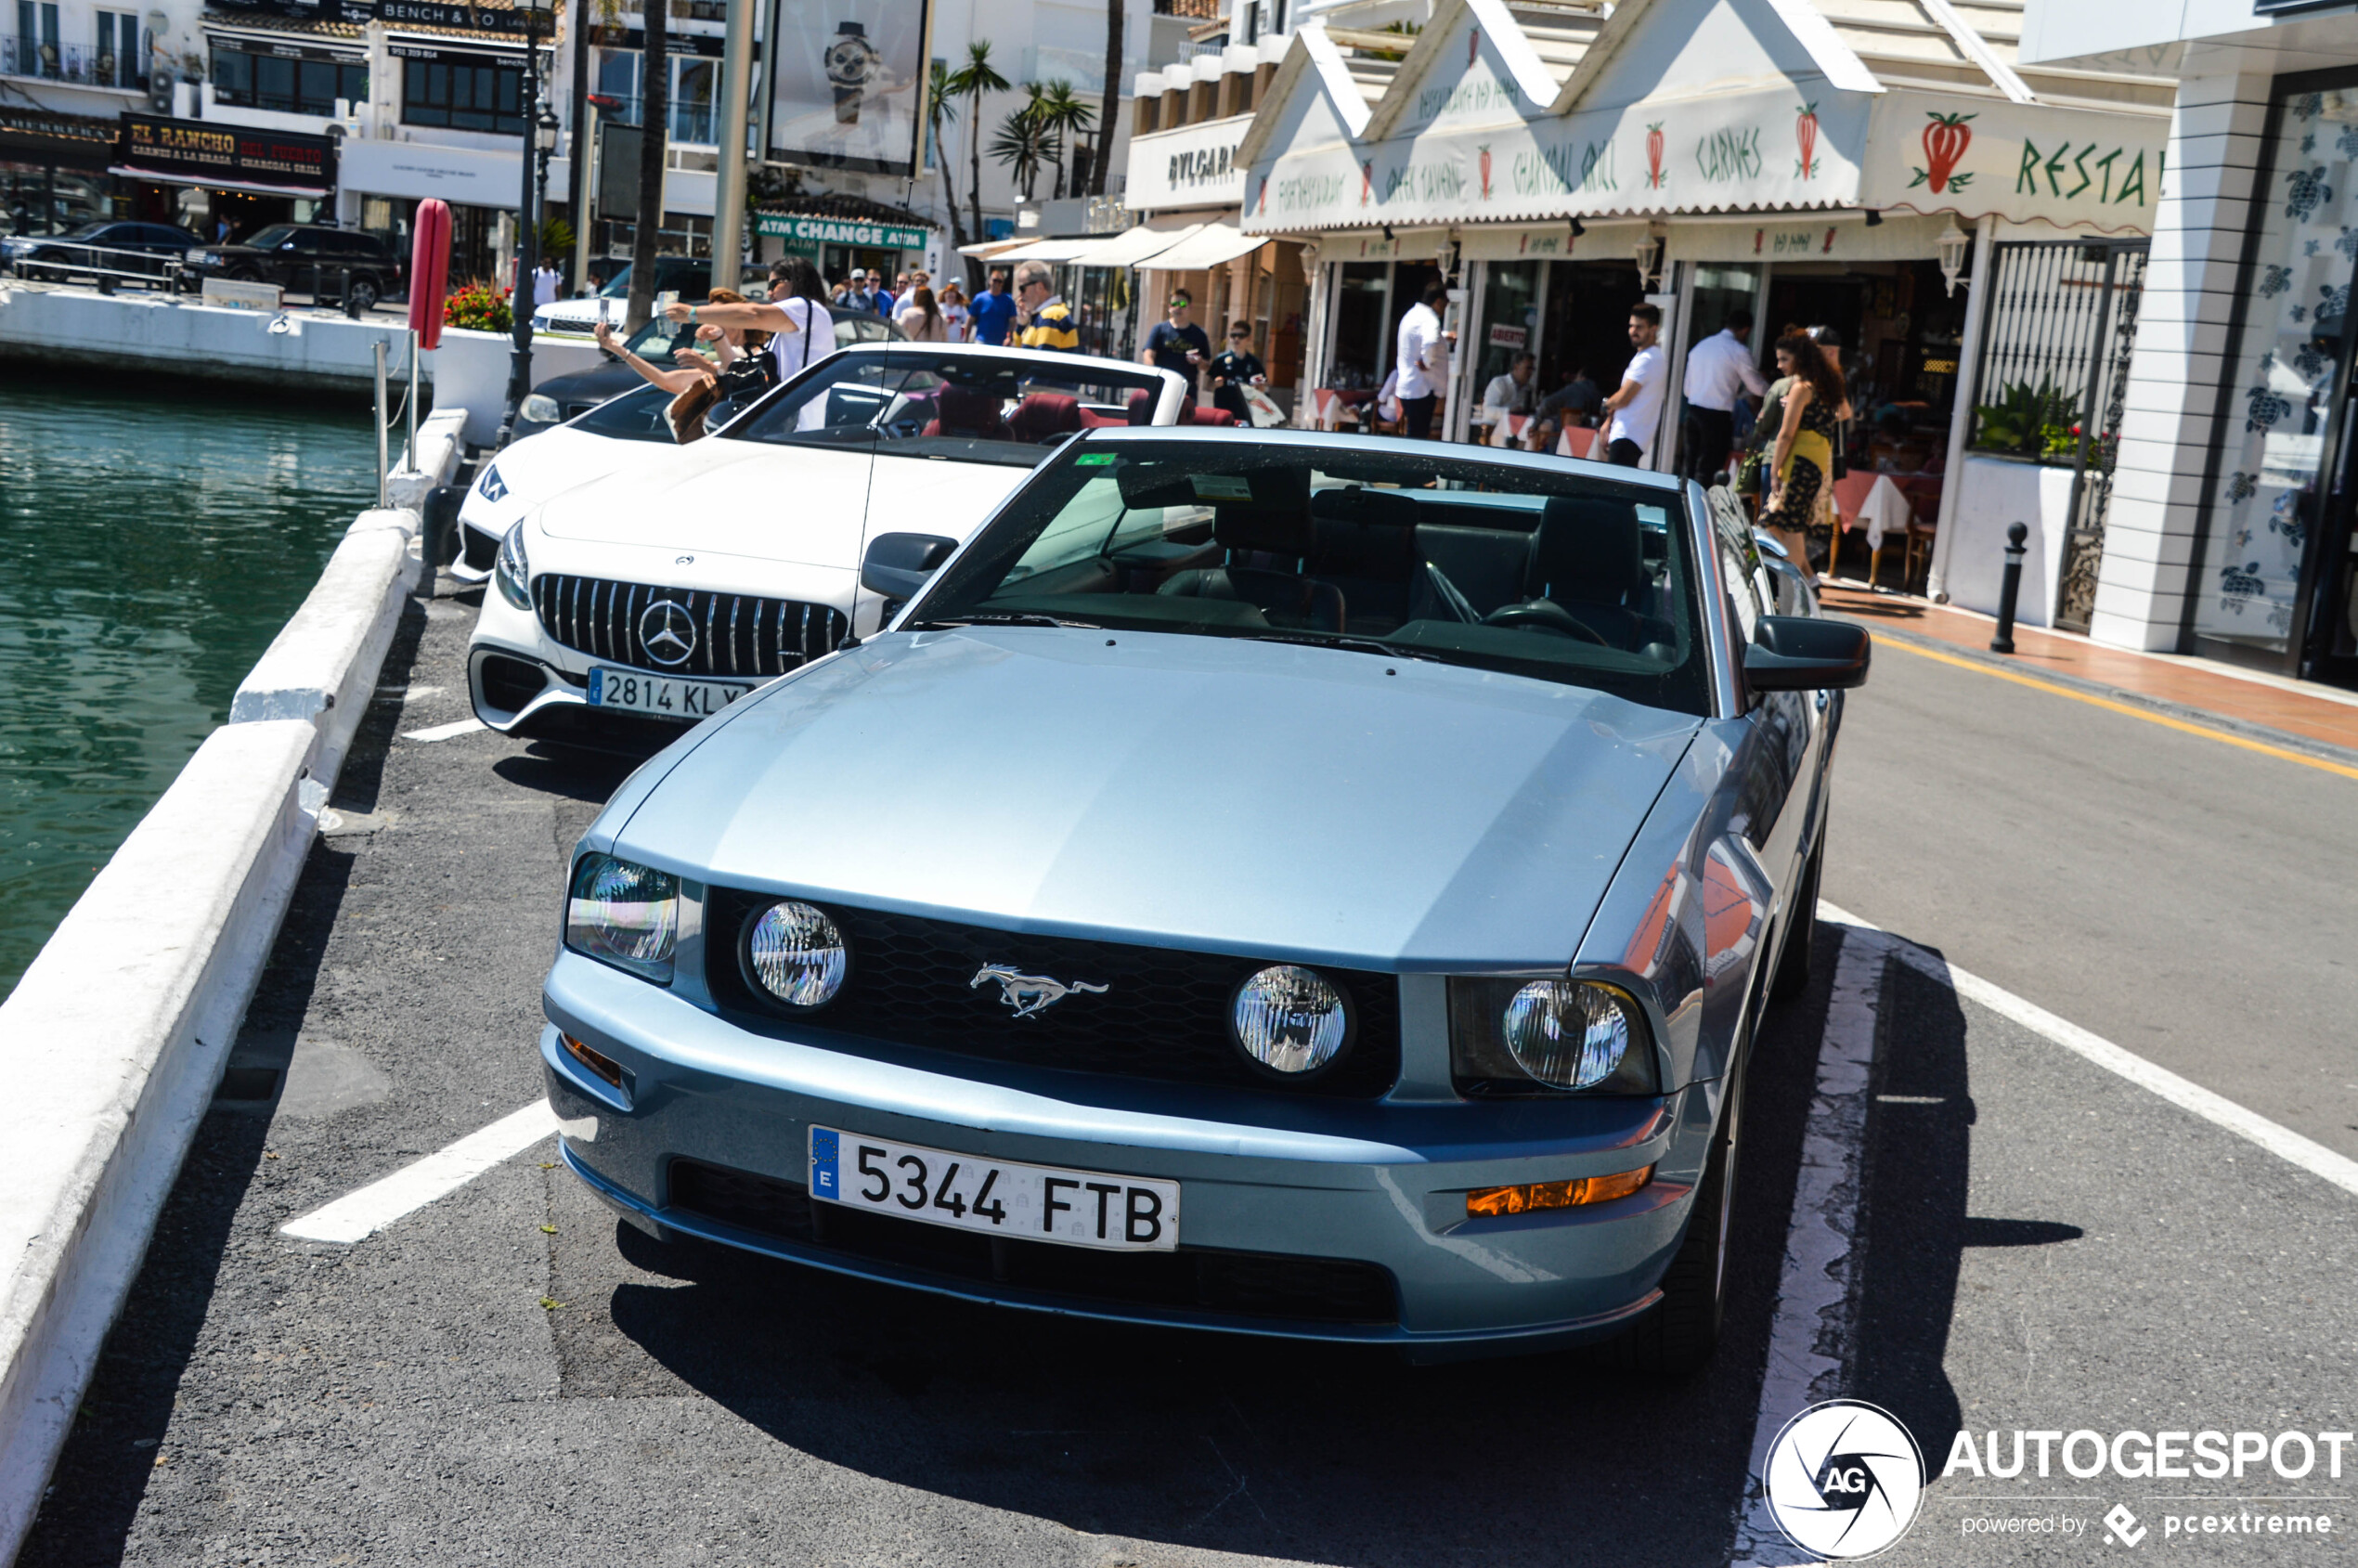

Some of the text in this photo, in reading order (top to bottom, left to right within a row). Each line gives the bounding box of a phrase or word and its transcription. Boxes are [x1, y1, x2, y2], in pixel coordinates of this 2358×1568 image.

[383, 4, 445, 21] BENCH
[451, 10, 463, 23] &
[131, 124, 322, 163] EL RANCHO DEL PUERTO
[174, 149, 181, 160] A
[183, 151, 197, 162] LA
[1696, 125, 1763, 184] CARNES
[758, 219, 792, 234] ATM
[796, 221, 882, 245] CHANGE
[887, 230, 920, 247] ATM
[1492, 328, 1525, 343] ABIERTO
[606, 676, 673, 710] 2814
[819, 1171, 832, 1187] E
[858, 1145, 1162, 1243] 5344 FTB
